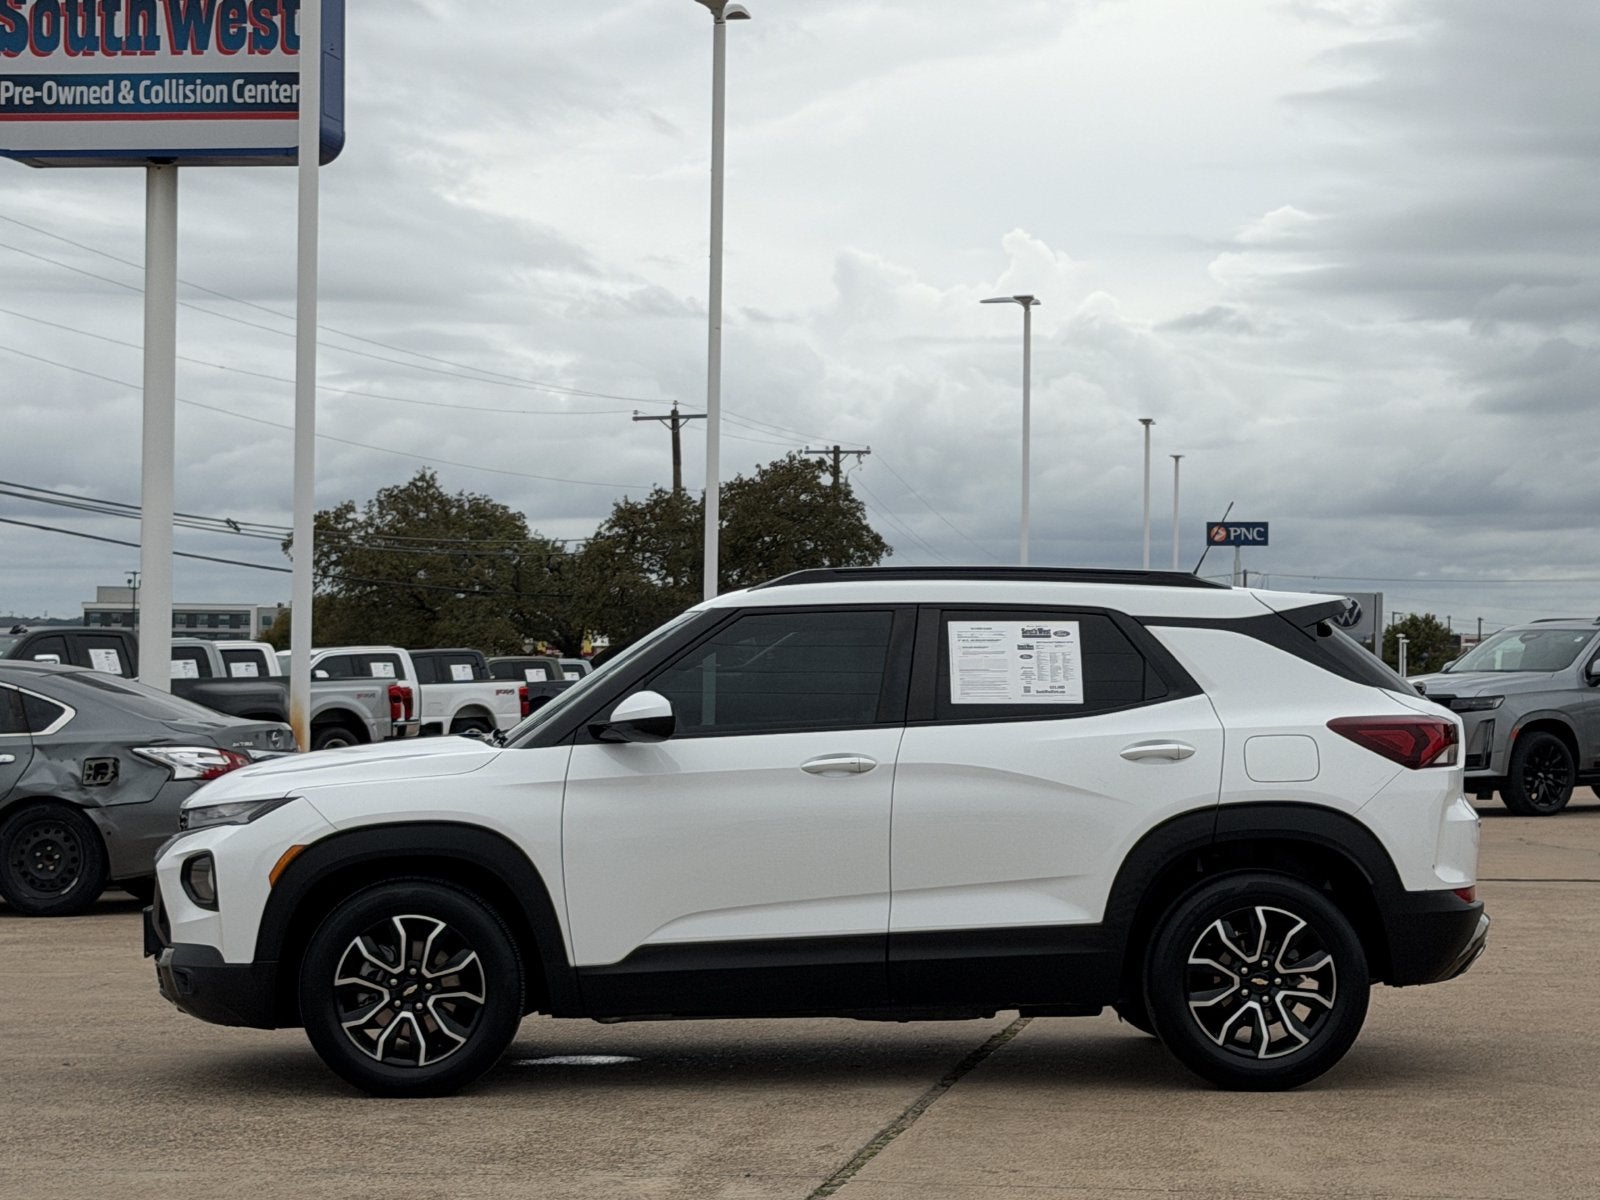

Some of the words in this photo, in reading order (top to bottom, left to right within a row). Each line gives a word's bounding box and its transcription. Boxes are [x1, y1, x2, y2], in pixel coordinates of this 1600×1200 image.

[0, 80, 114, 105] Pre-Owned
[118, 80, 135, 104] &
[139, 79, 228, 104] Collision
[1228, 527, 1265, 541] PNC
